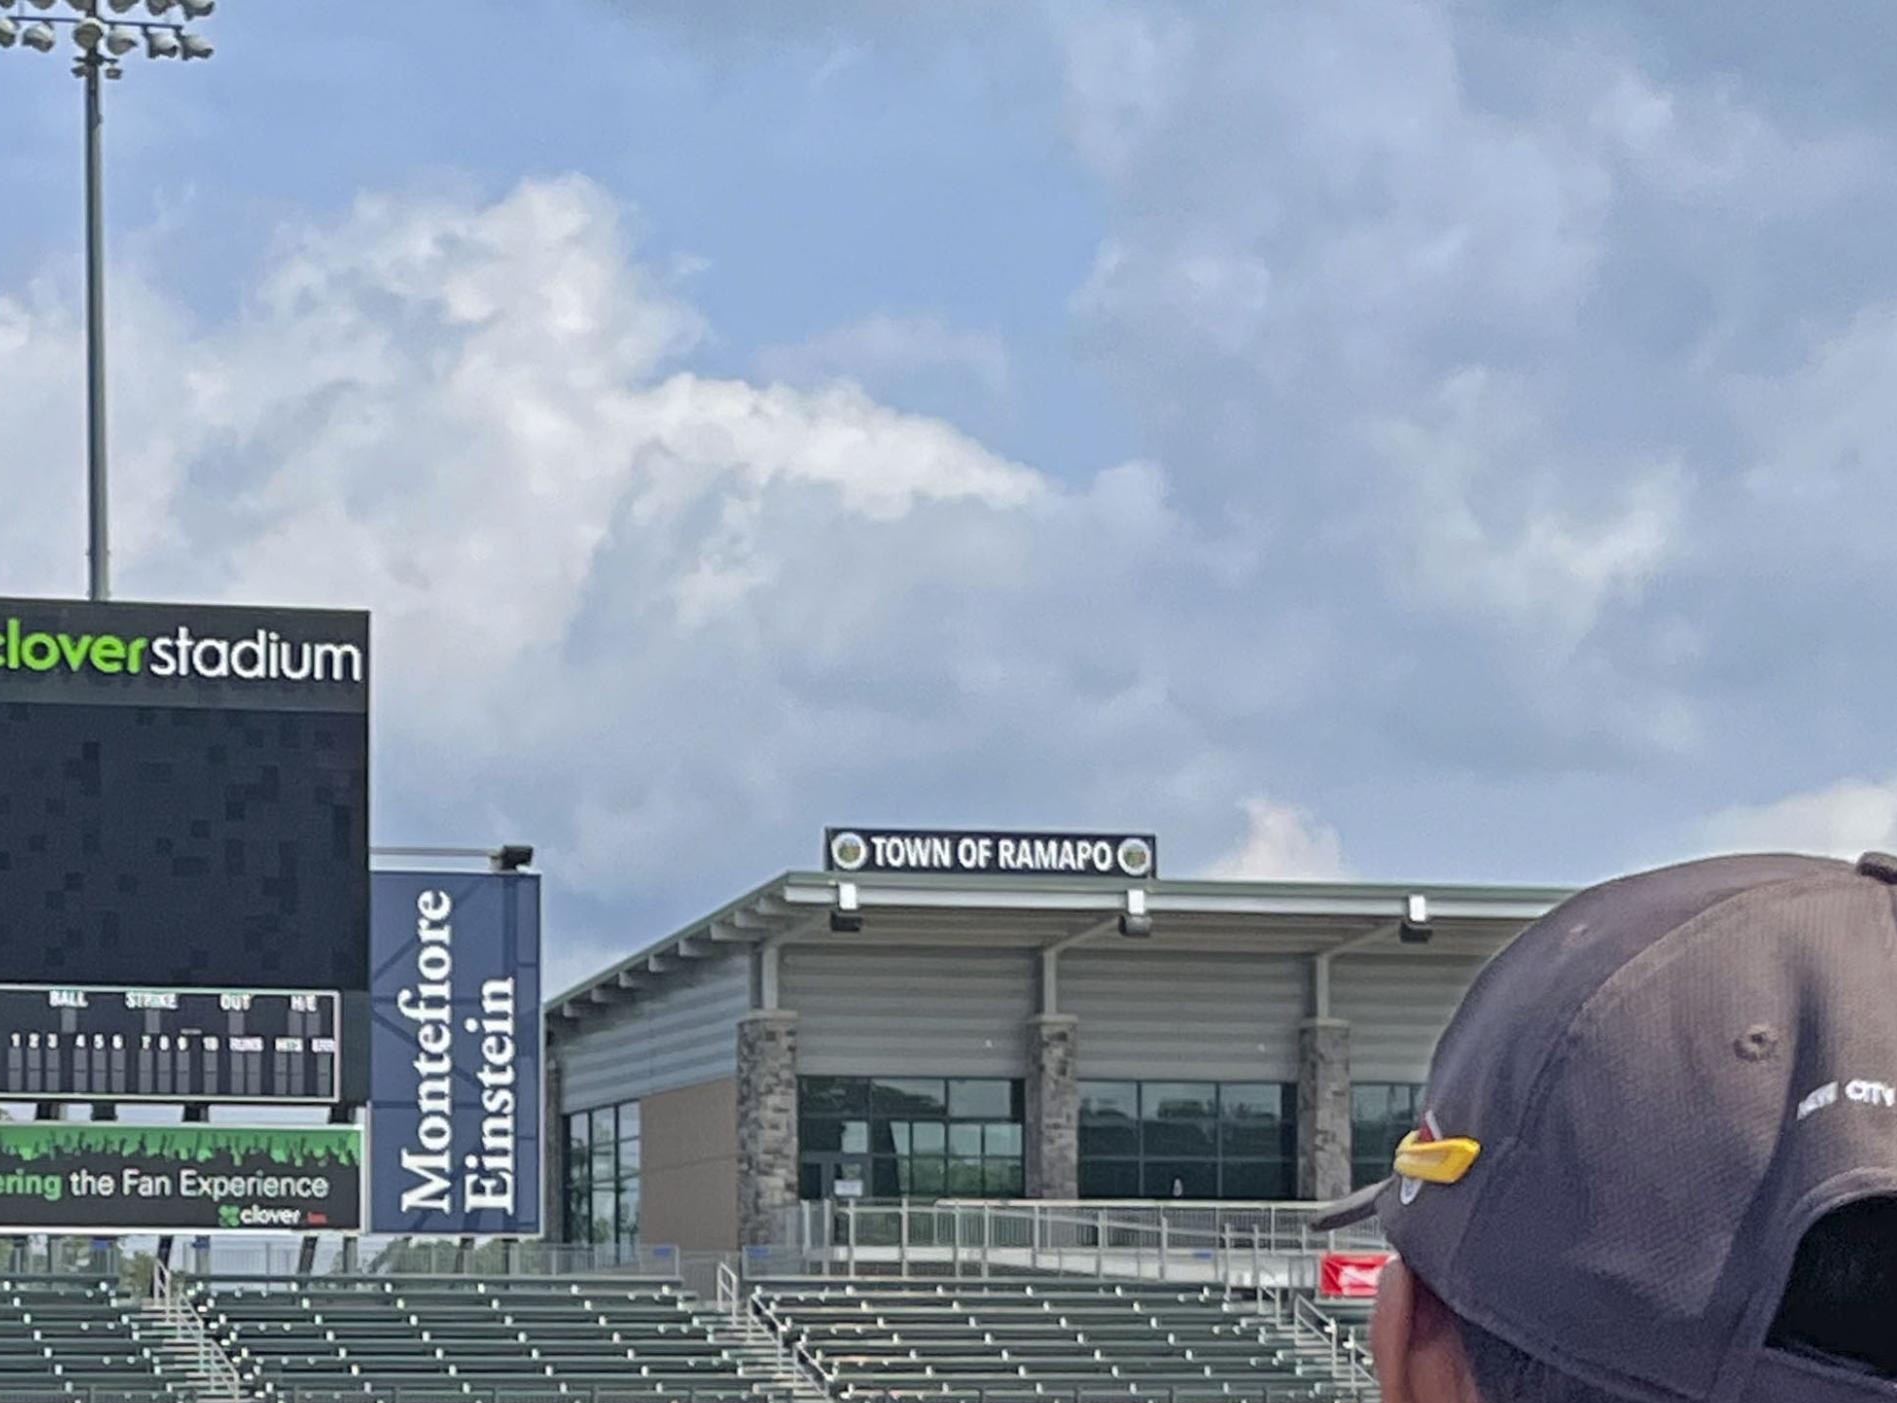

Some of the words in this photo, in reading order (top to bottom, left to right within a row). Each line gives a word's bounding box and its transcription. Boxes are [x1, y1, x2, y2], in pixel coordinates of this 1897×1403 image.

[871, 837, 951, 868] TOWN
[958, 838, 993, 869] OF
[998, 839, 1113, 872] RAMAPO
[49, 991, 88, 1008] BALL
[125, 992, 178, 1010] STRIKE
[220, 993, 252, 1011] OUT
[11, 1033, 21, 1048] 1
[29, 1033, 40, 1048] 2
[47, 1033, 58, 1048] 3
[75, 1034, 86, 1048] 4
[93, 1034, 104, 1049] 5
[112, 1034, 123, 1049] 6
[141, 1035, 152, 1049] 7
[159, 1035, 170, 1050] 8
[177, 1036, 188, 1051] 9
[397, 889, 452, 1215] Montefiore
[464, 976, 515, 1216] Einstein
[70, 1169, 115, 1197] the
[122, 1168, 171, 1197] Fan
[179, 1169, 329, 1202] Experience
[240, 1204, 301, 1225] clover
